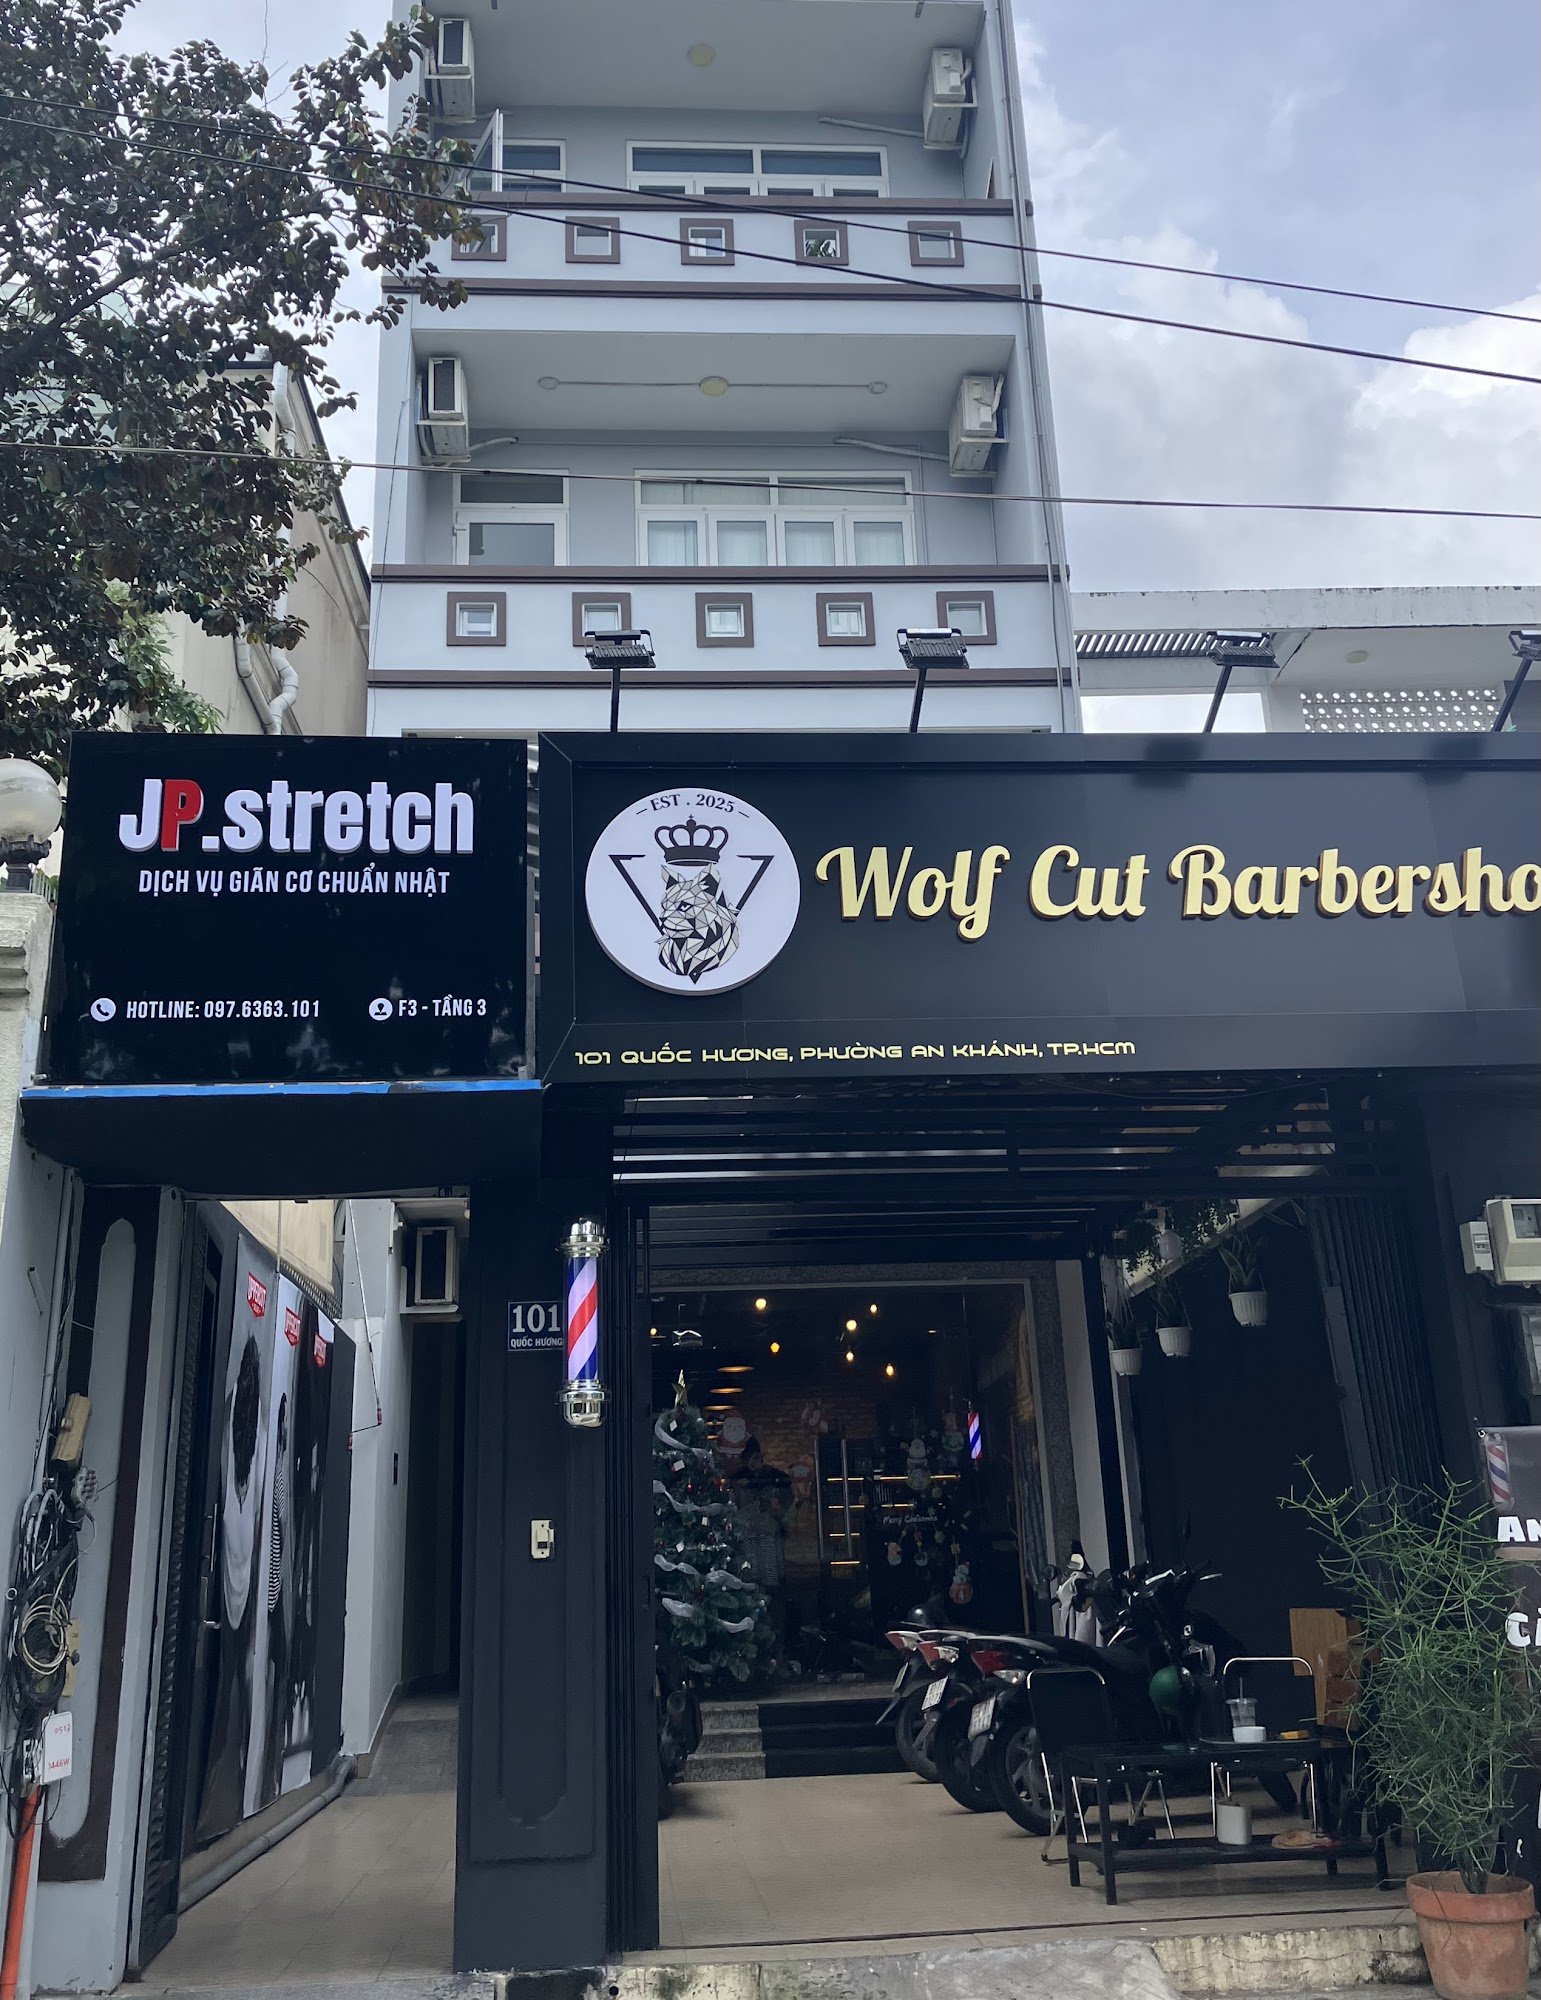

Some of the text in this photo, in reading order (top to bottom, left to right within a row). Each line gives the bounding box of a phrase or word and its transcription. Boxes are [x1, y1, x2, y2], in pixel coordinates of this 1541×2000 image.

[650, 794, 681, 811] EST
[695, 794, 735, 813] 2025
[139, 862, 450, 897] DỊCH VỤ GIÃN CƠ CHUẨN NHẬT
[815, 844, 1010, 942] Wolf
[1028, 846, 1149, 919] Cut
[126, 1000, 320, 1019] HOTLINE: 097.6363.101
[398, 999, 418, 1017] F3
[432, 994, 473, 1017] TẦNG
[477, 999, 487, 1016] 3
[575, 1039, 1136, 1065] 101 QUỐC HƯƠNG, PHƯỜNG AN KHÁNH, TP.HCM
[512, 1303, 561, 1333] 101
[510, 1335, 564, 1349] QUỐC HƯƠNG
